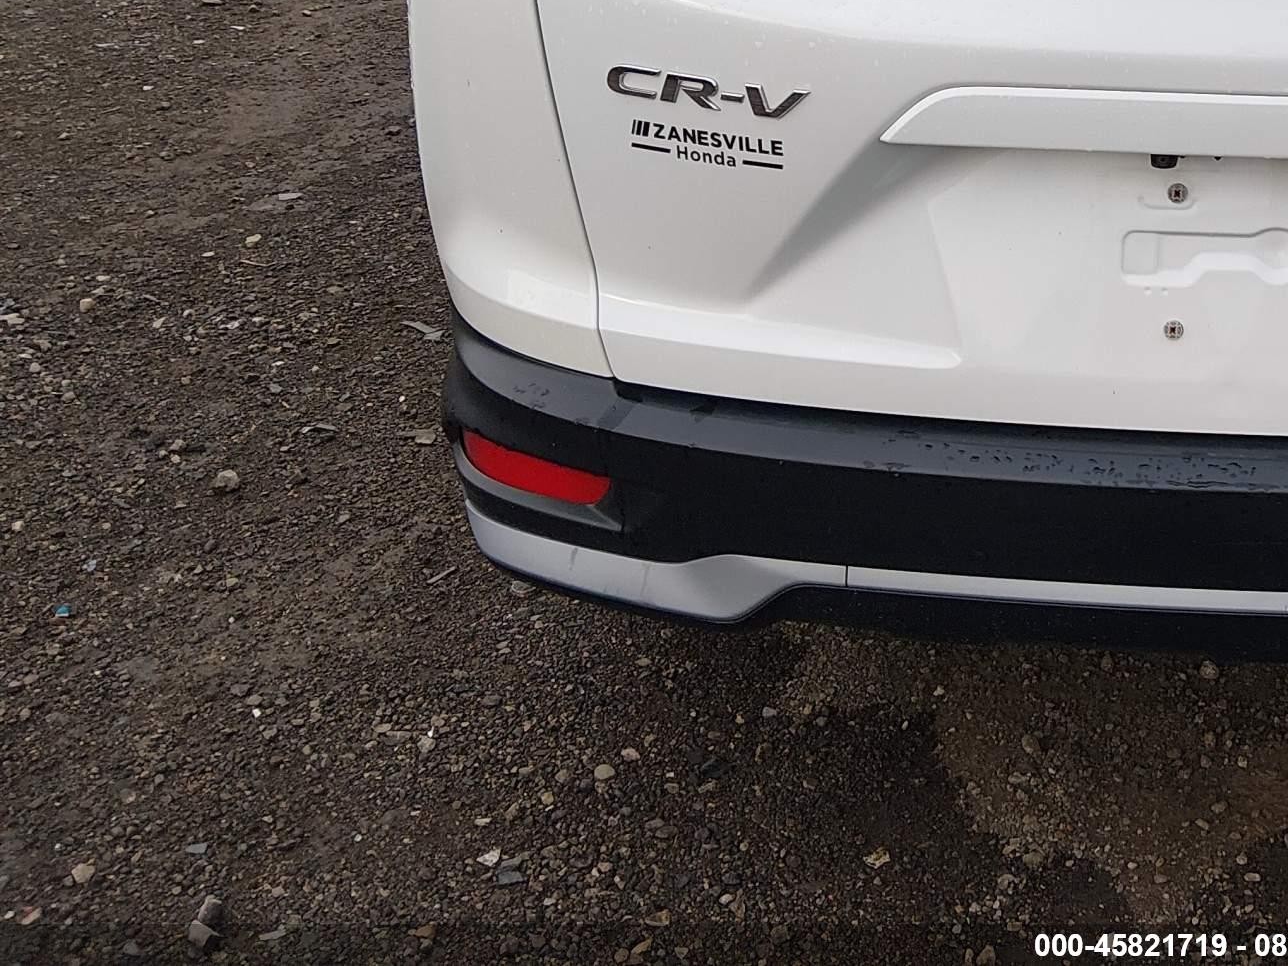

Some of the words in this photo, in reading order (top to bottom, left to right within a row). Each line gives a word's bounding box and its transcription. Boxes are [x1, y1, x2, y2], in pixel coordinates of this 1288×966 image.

[606, 63, 811, 119] CR-V
[652, 123, 784, 156] ZANESVILLE
[676, 145, 736, 167] Honda
